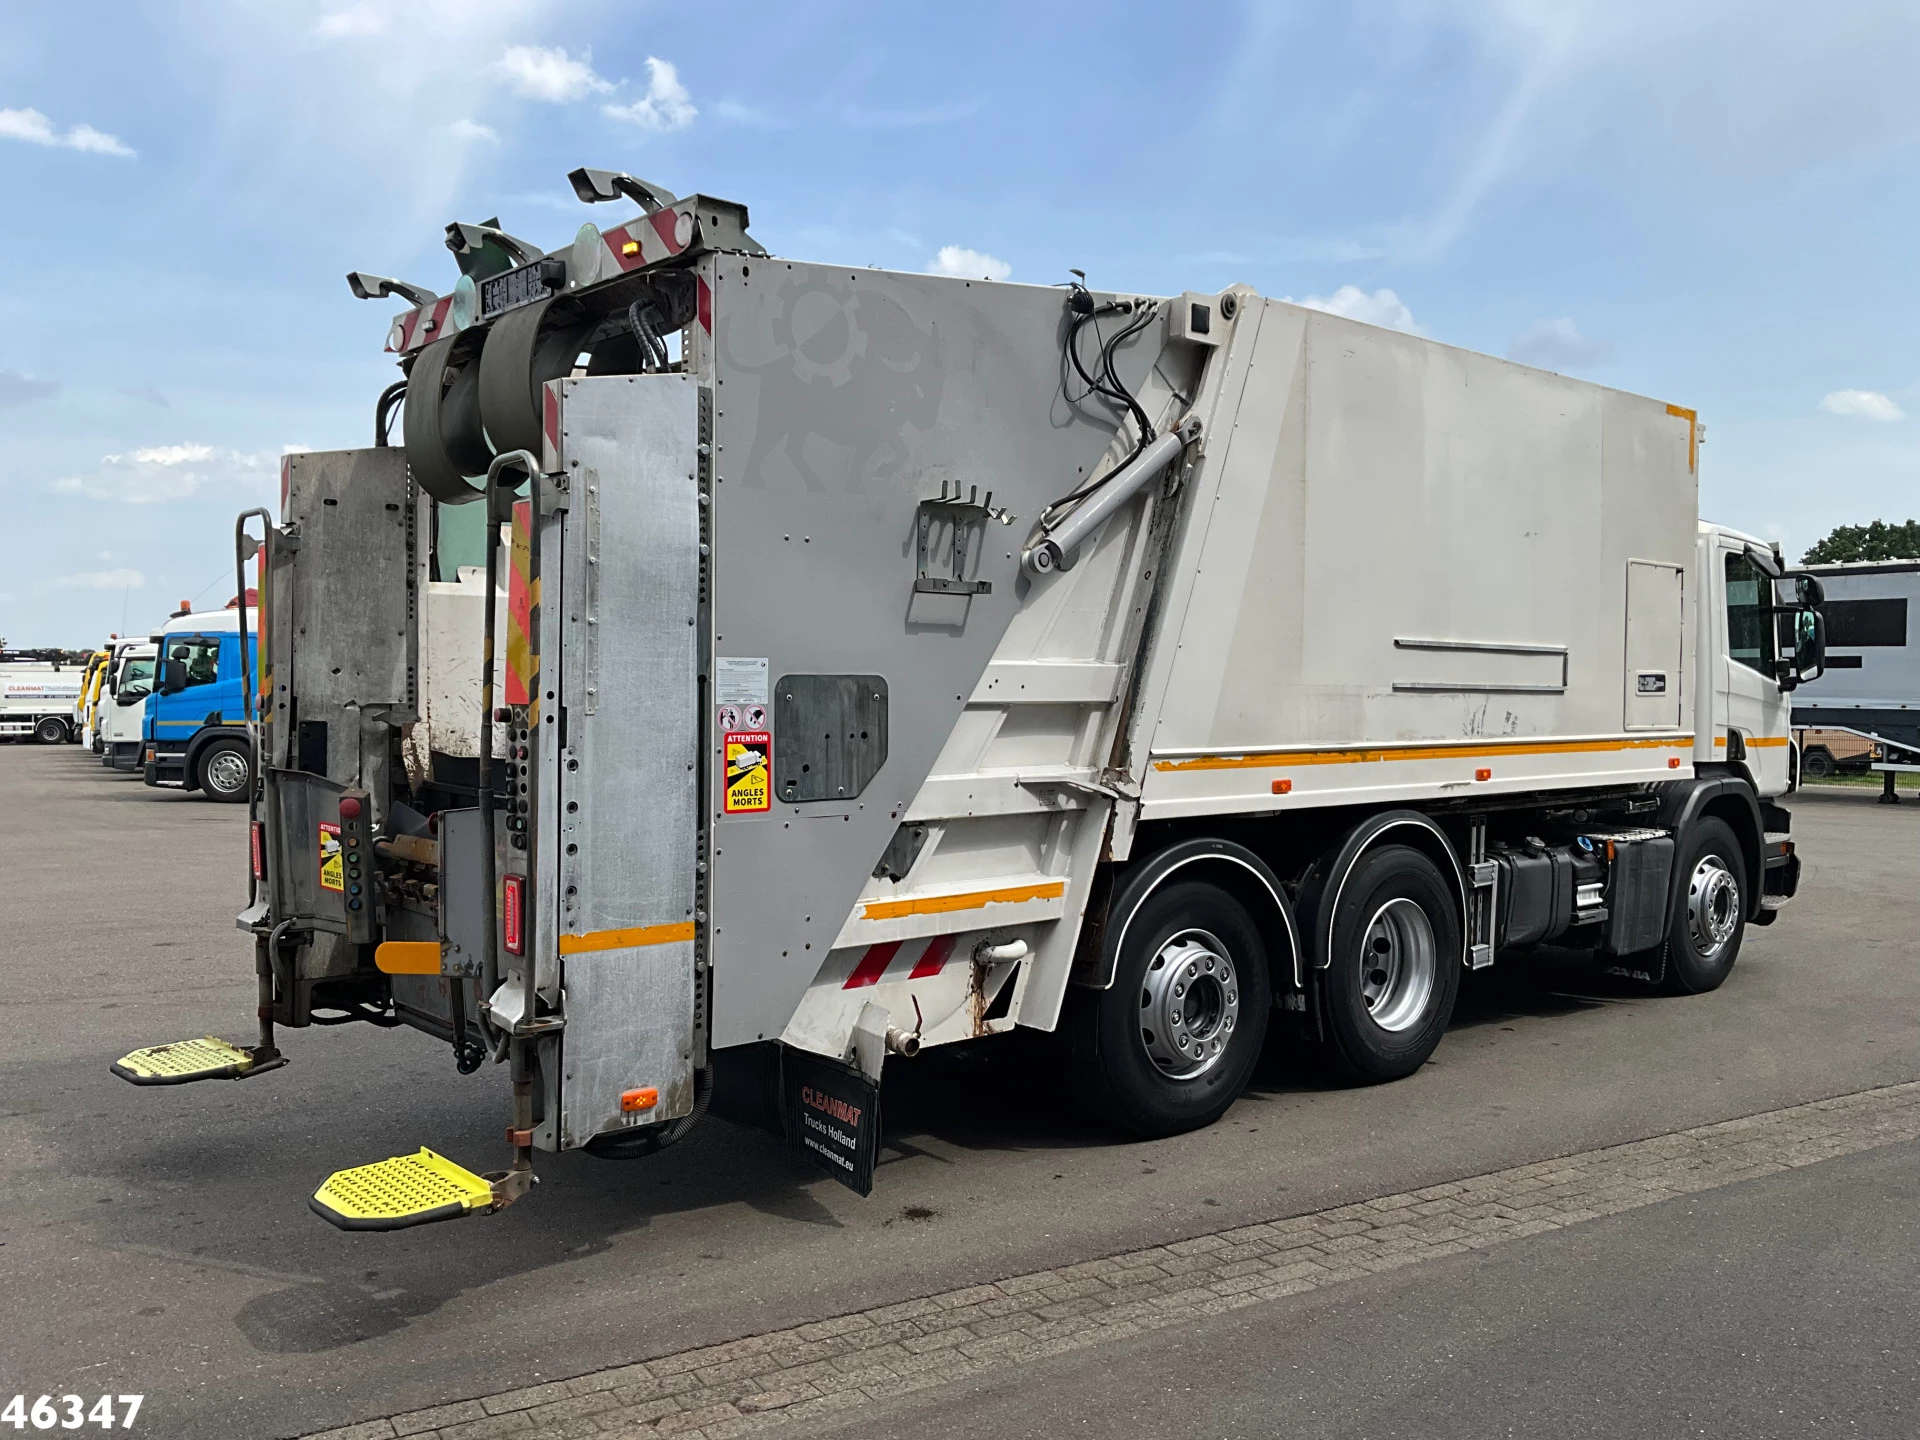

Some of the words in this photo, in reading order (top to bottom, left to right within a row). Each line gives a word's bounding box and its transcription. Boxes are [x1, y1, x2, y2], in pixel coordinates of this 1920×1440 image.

[727, 734, 768, 743] ATTENTION
[731, 788, 764, 798] ANGLES
[733, 797, 763, 807] MORTS
[320, 823, 341, 834] ATTENTIO
[323, 869, 342, 879] ANGLES
[324, 876, 342, 887] MORTS
[801, 1086, 862, 1127] CLEANMAT
[803, 1112, 827, 1135] Trucks
[828, 1124, 856, 1150] Holland
[804, 1136, 854, 1172] www.cleanmat.eu
